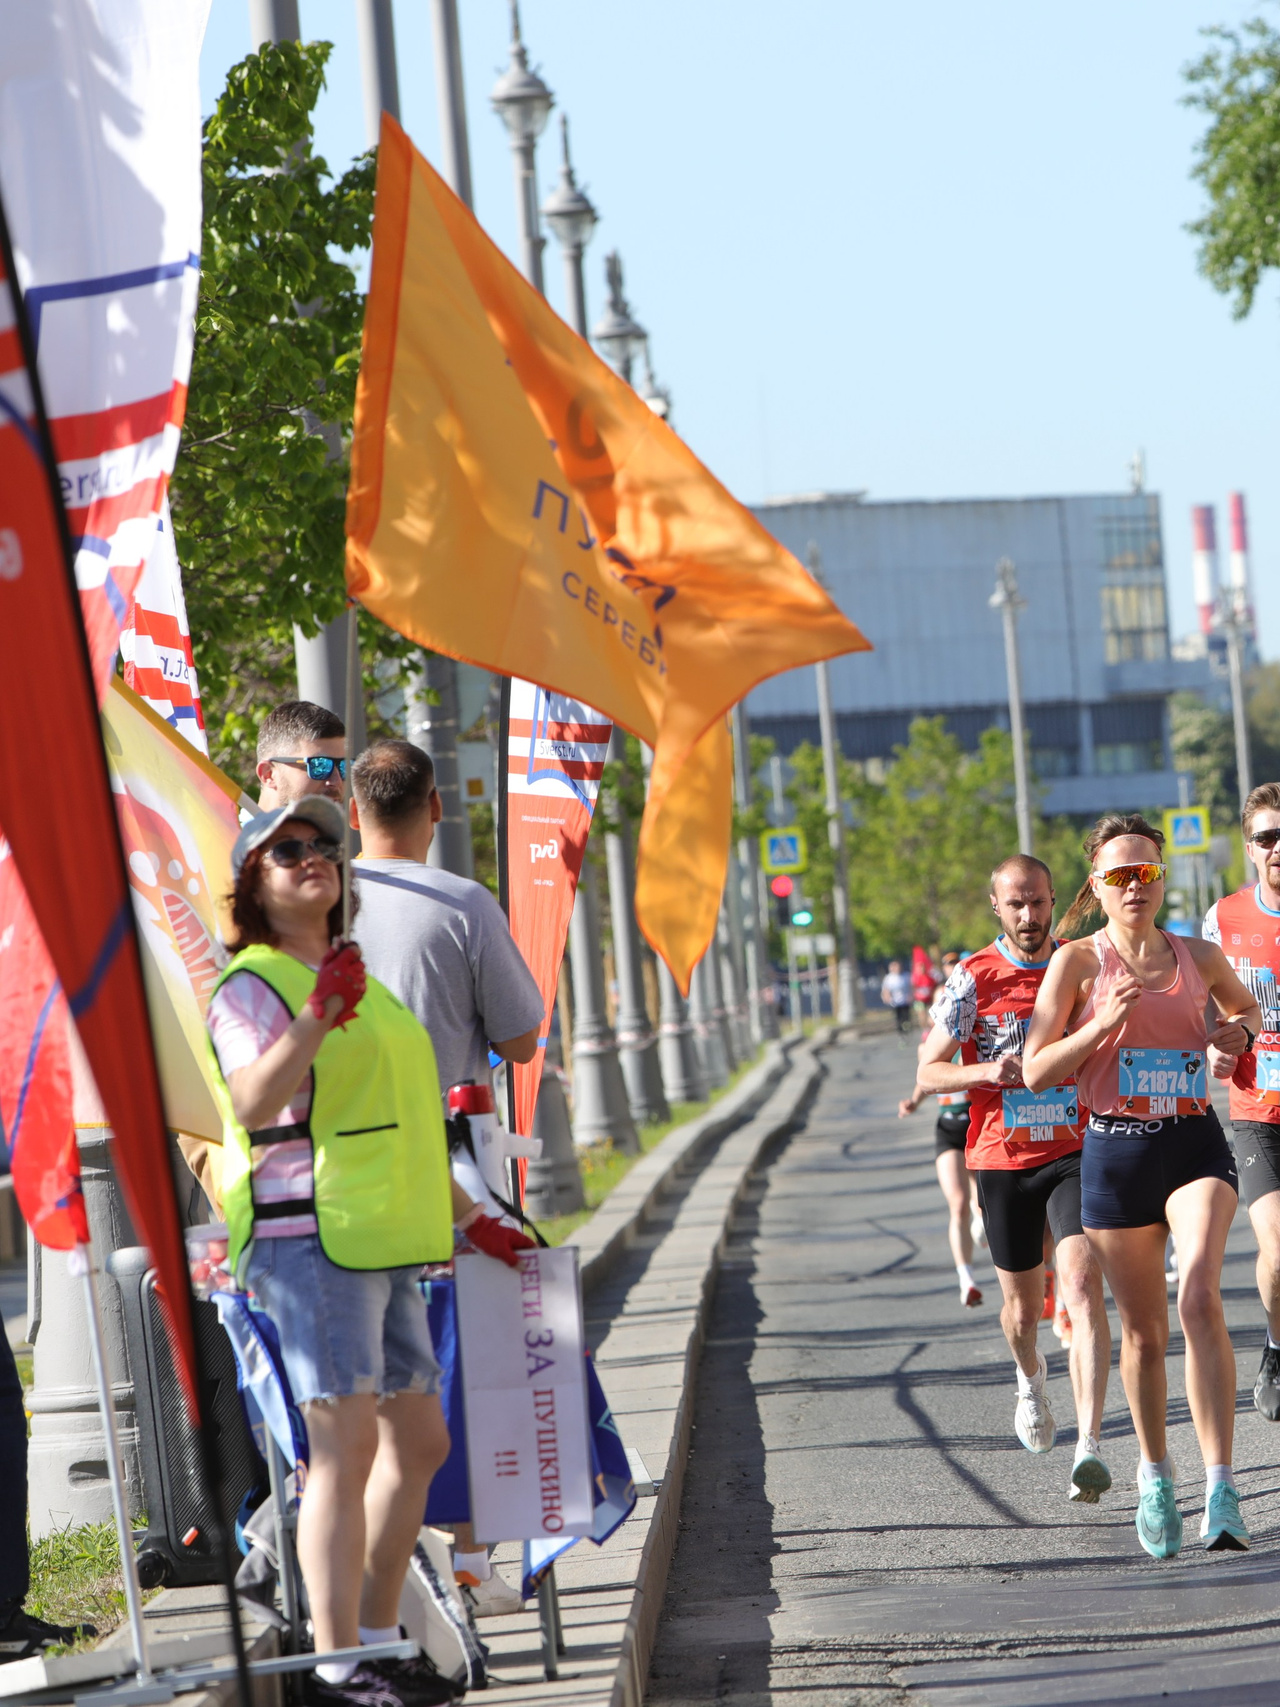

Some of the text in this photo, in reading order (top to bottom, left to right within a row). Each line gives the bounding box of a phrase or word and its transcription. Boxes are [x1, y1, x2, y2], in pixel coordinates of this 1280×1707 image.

[562, 571, 668, 676] СЕРЕБ
[540, 741, 576, 758] 5verst.ru
[1187, 1064, 1196, 1073] A
[1137, 1070, 1189, 1094] 21874
[1017, 1103, 1065, 1125] 25903
[1067, 1107, 1075, 1116] A
[1149, 1096, 1178, 1115] 5KM
[1029, 1125, 1054, 1142] 5KM
[1110, 1120, 1164, 1135] PRO
[524, 1328, 556, 1381] ЗА
[532, 1387, 565, 1534] ПУШКИНО
